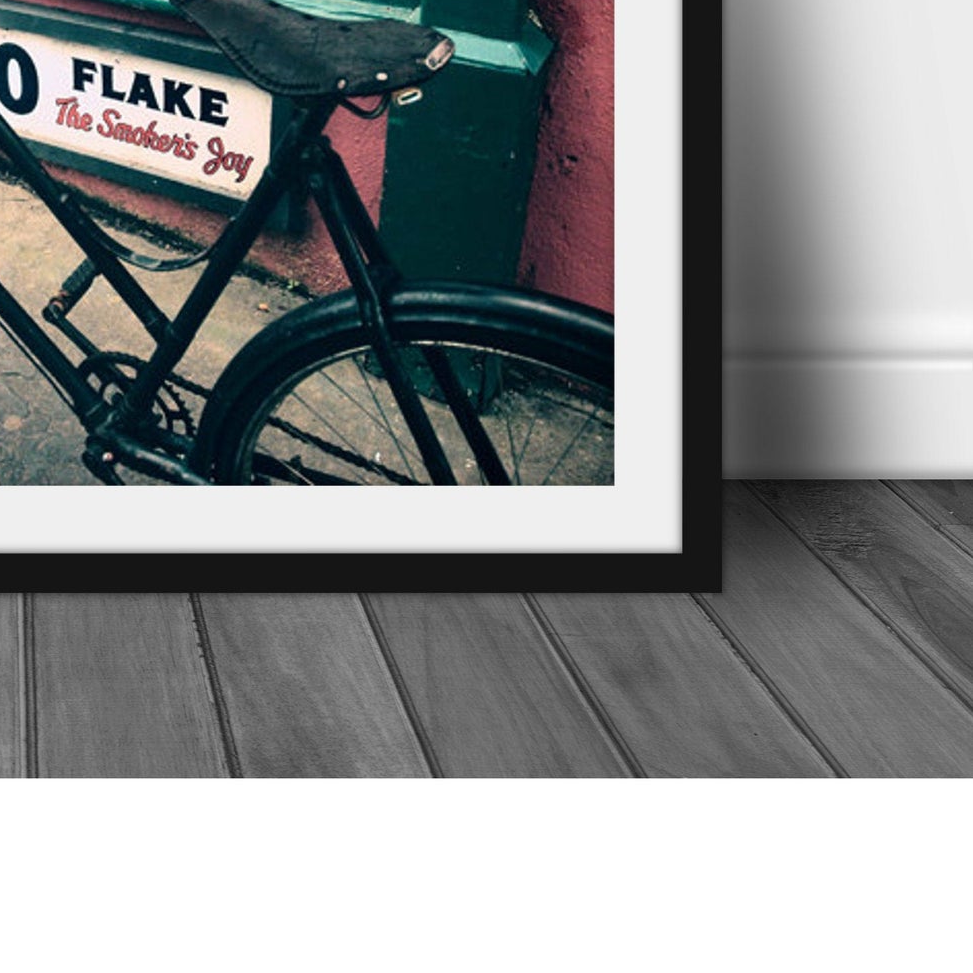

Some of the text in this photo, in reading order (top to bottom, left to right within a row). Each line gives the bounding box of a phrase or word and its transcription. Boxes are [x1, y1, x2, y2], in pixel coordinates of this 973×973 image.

[71, 57, 229, 127] FLAKE
[55, 97, 93, 132] The
[202, 136, 255, 184] Joy
